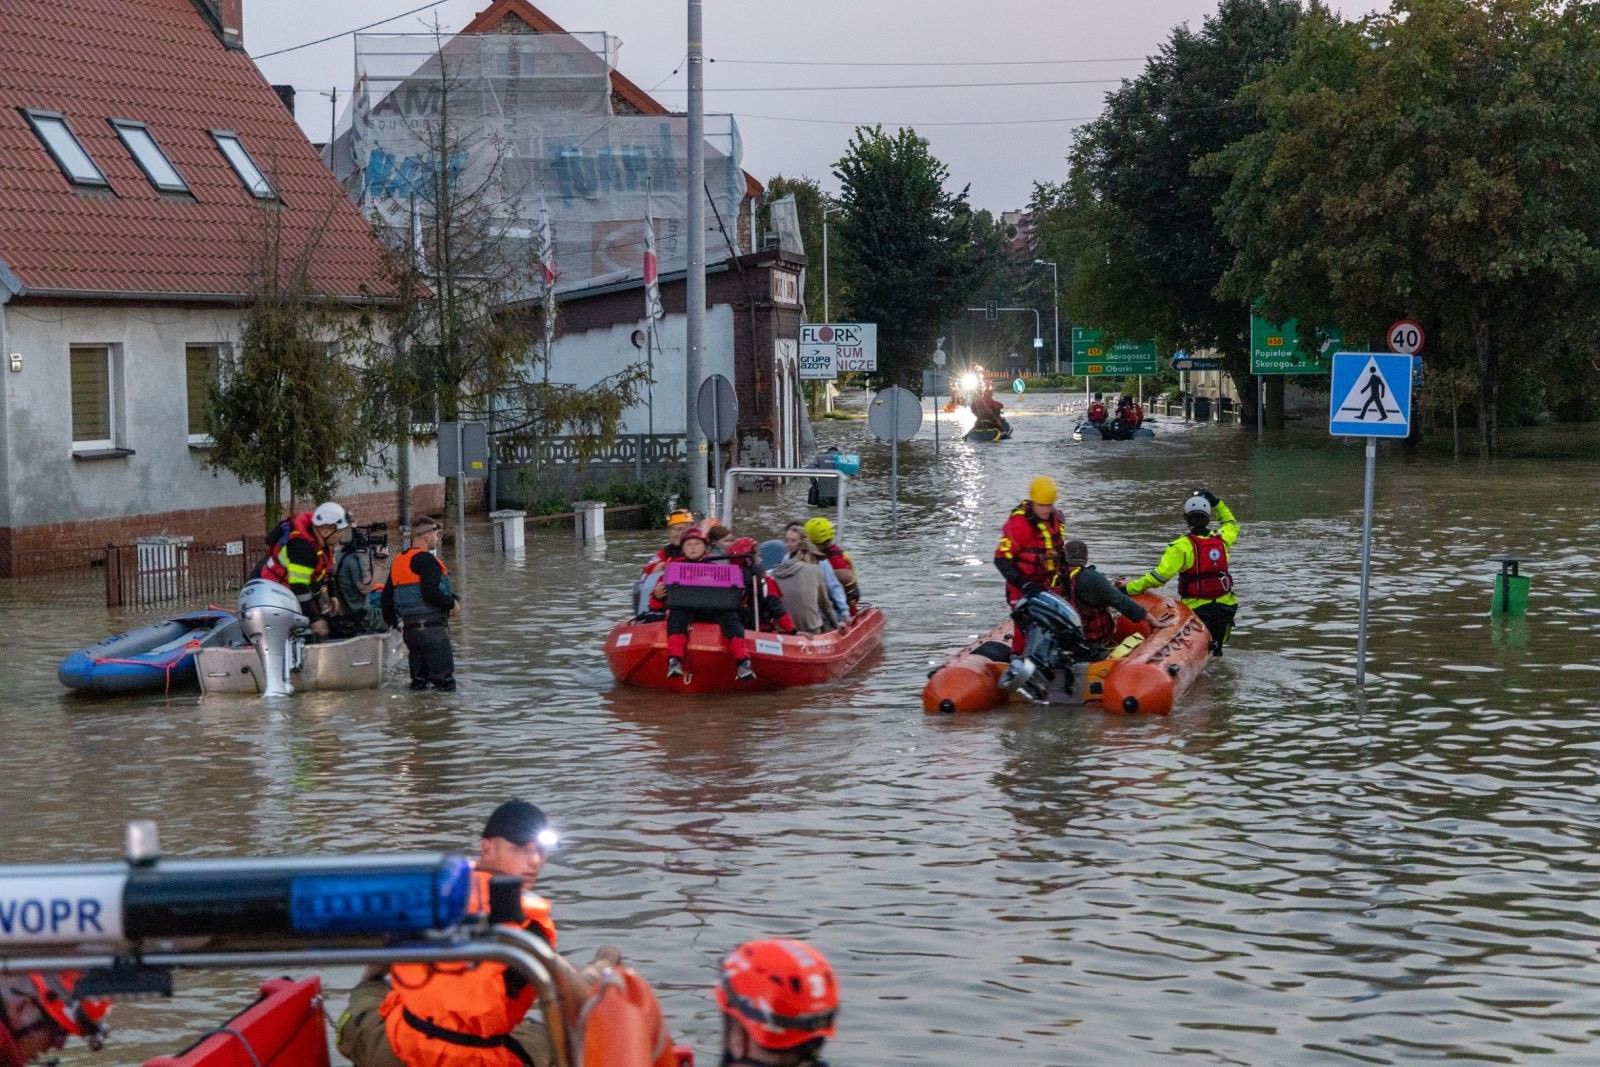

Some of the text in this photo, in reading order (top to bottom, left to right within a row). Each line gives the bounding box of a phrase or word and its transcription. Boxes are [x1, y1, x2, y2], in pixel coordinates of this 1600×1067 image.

[803, 327, 858, 342] FLORA
[1393, 330, 1418, 347] 40
[837, 348, 863, 358] RUM
[837, 360, 874, 371] NICZE
